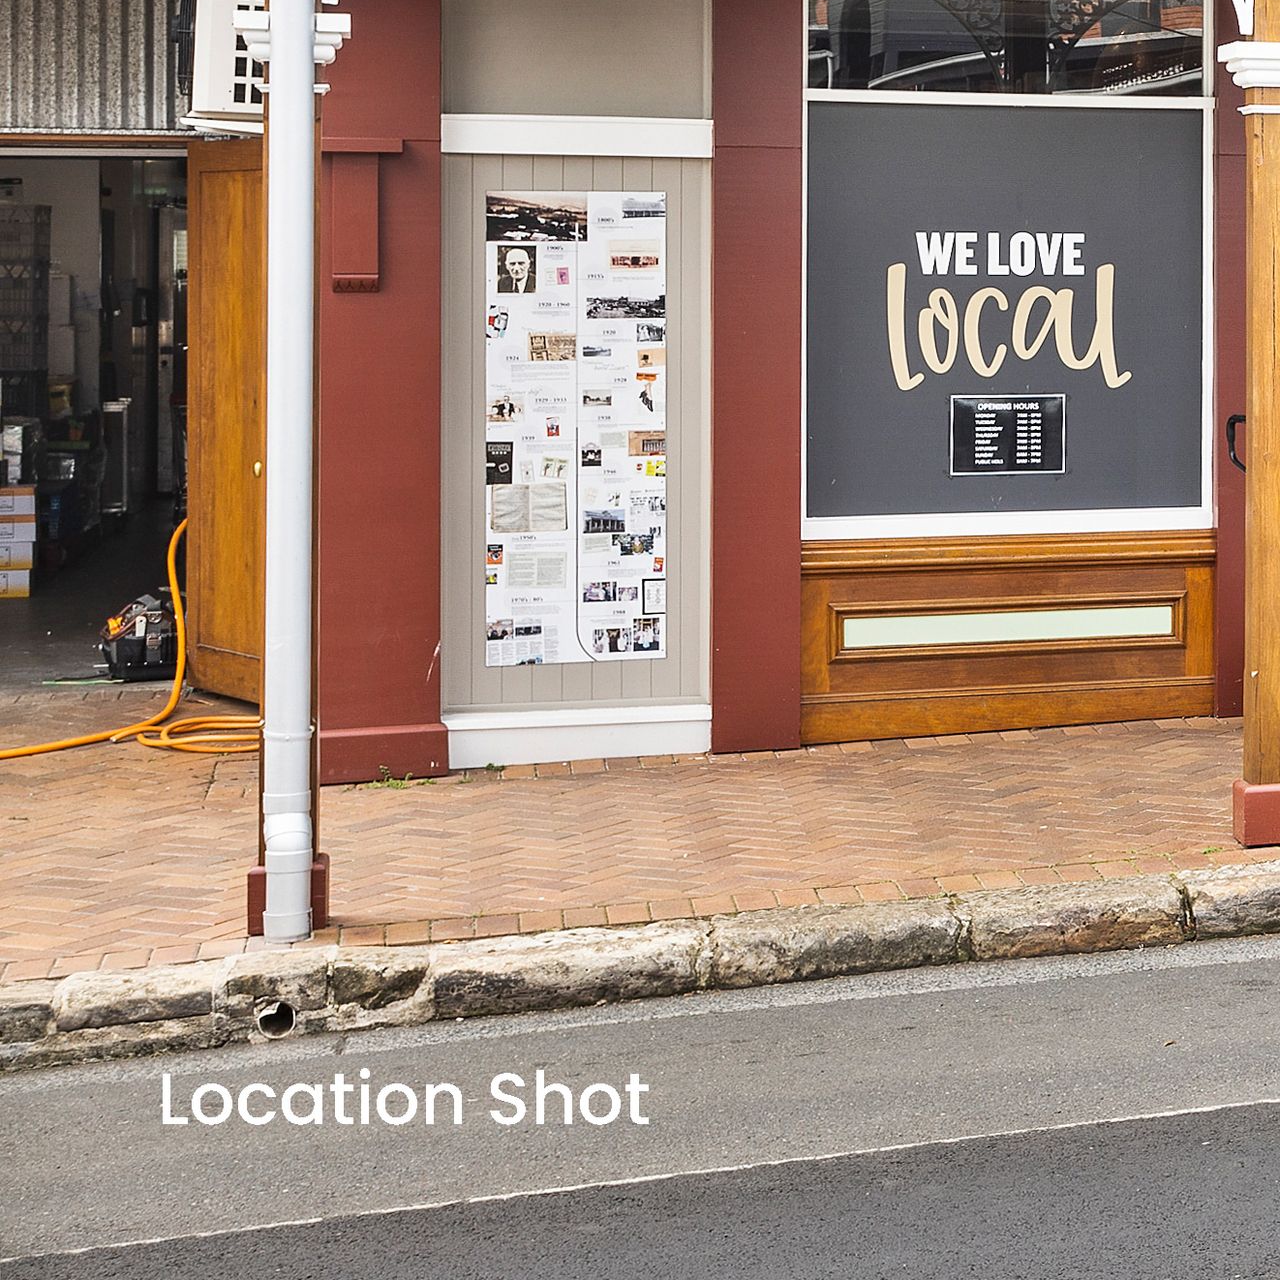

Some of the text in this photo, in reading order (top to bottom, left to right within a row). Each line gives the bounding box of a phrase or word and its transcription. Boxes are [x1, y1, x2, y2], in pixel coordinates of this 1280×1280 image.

[916, 231, 1085, 276] WE LOVE
[887, 262, 1133, 390] local
[977, 402, 1039, 411] OPENING HOURS
